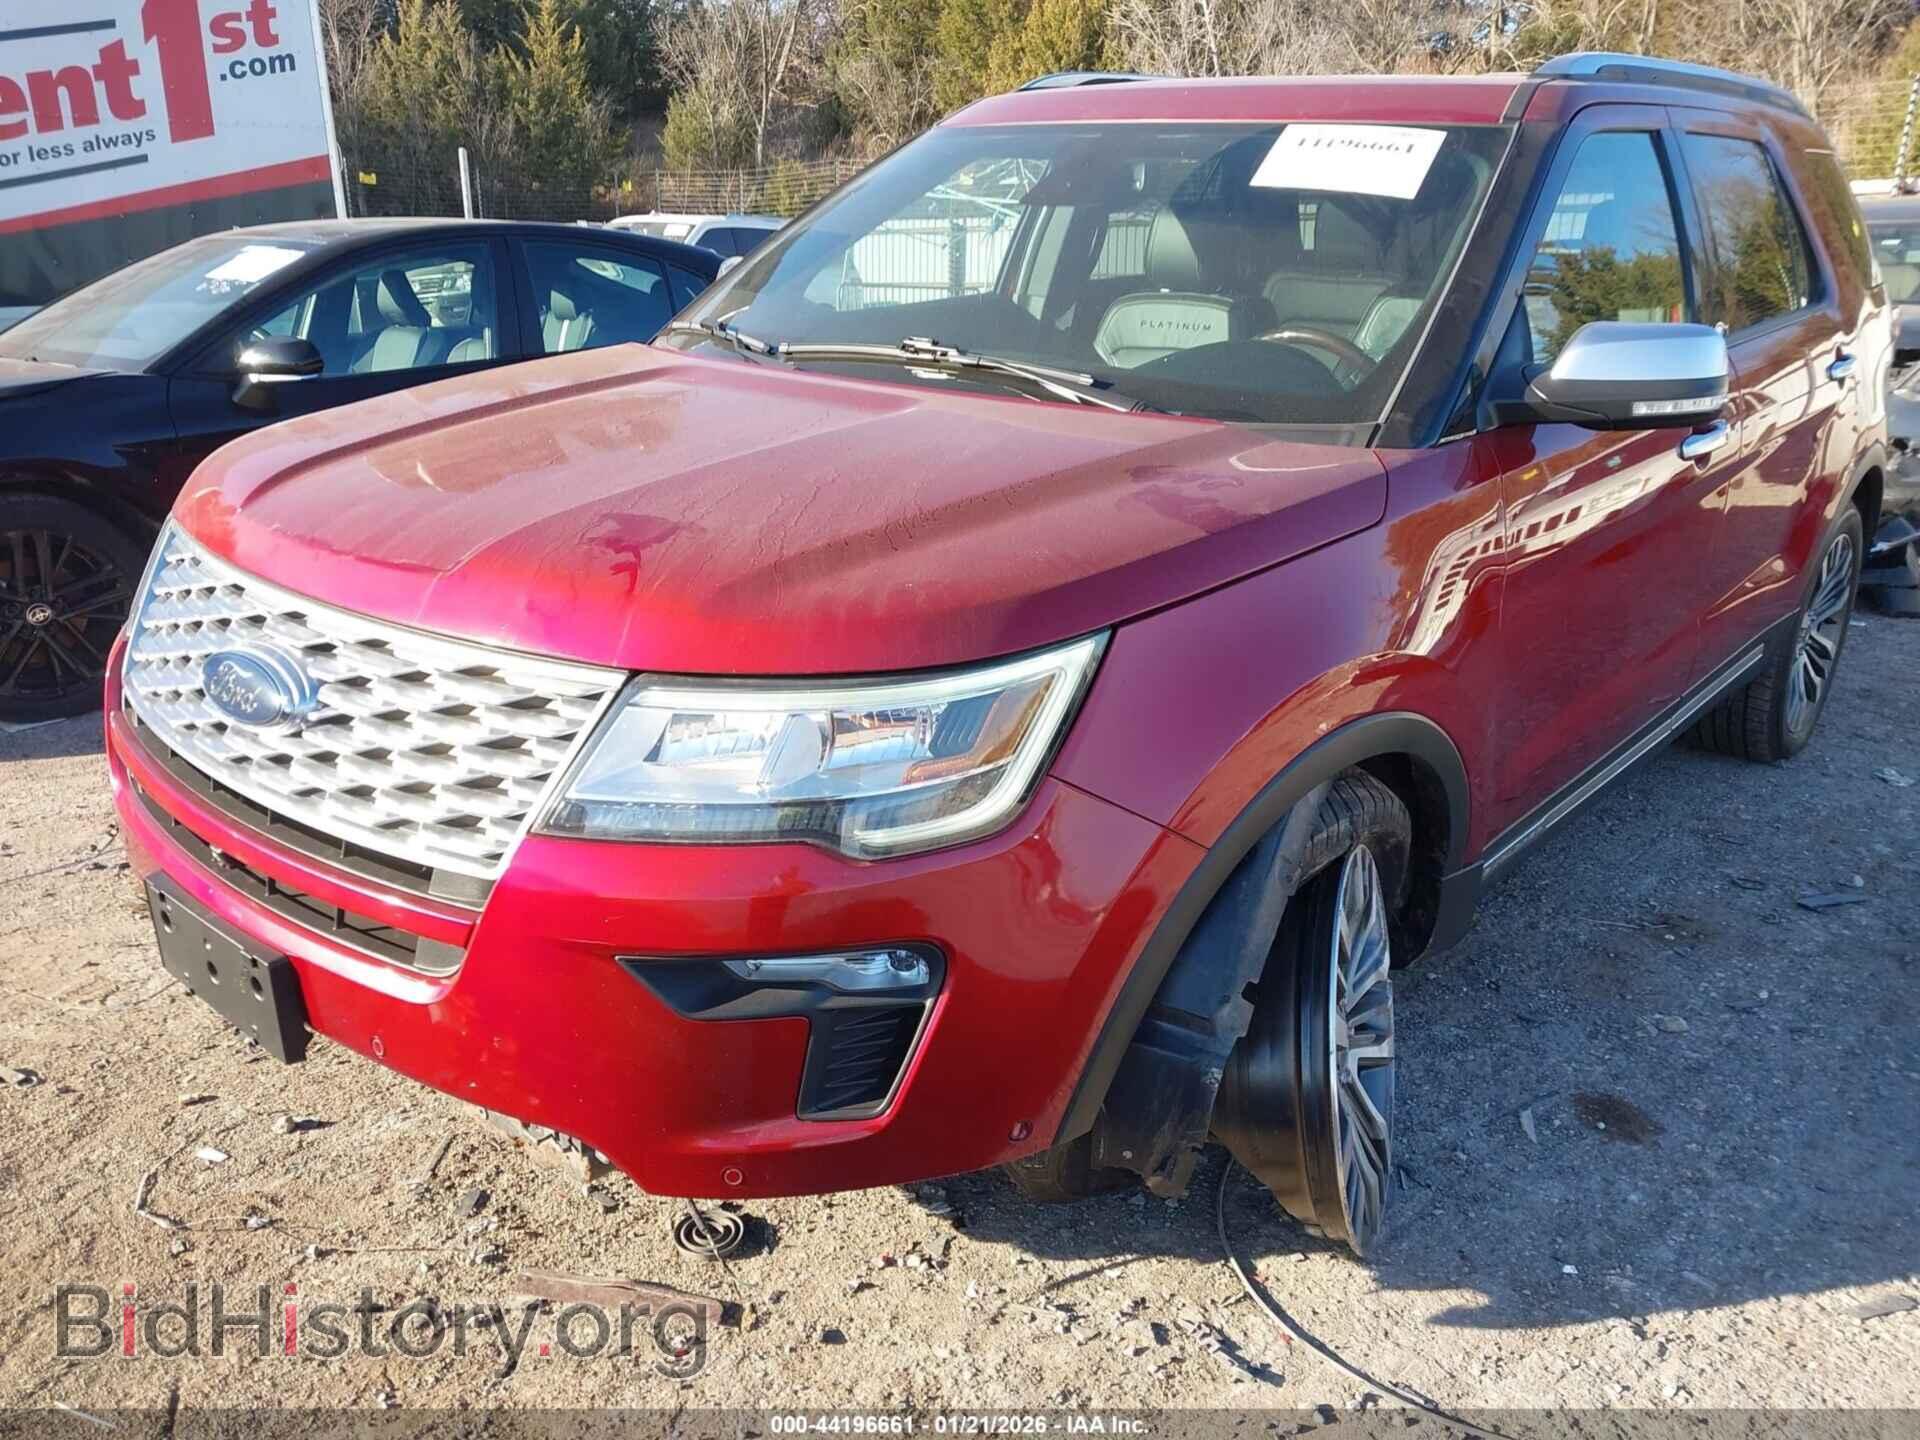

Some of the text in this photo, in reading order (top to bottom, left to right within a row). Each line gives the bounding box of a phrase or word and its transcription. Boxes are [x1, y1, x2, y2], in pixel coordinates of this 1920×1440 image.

[219, 52, 297, 82] .com
[28, 142, 75, 163] less
[82, 128, 156, 153] always
[1140, 319, 1212, 331] PLATINUM
